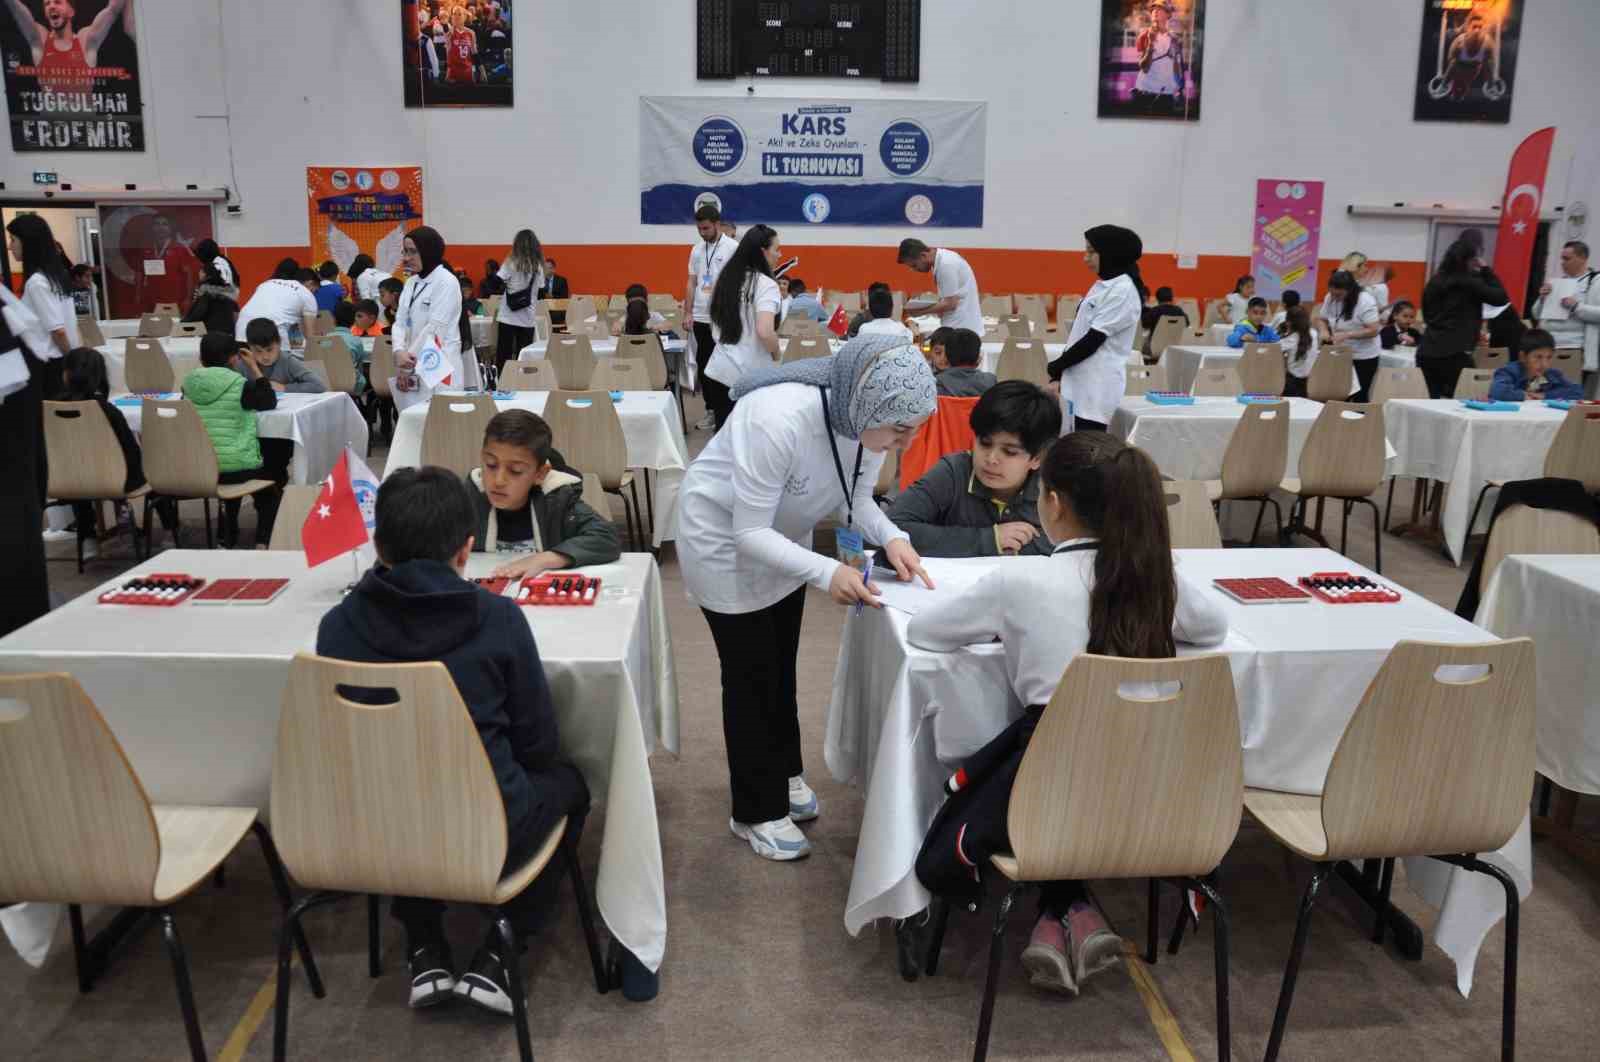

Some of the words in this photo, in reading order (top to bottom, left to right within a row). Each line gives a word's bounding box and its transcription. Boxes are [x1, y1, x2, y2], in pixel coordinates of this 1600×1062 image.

[766, 19, 782, 27] SCORE
[804, 48, 813, 56] SET
[20, 85, 128, 113] TUĞRULHAN
[23, 114, 132, 148] ERDEMİR
[782, 113, 846, 136] KARS
[766, 155, 779, 174] İL
[782, 157, 860, 175] TURNUVASI
